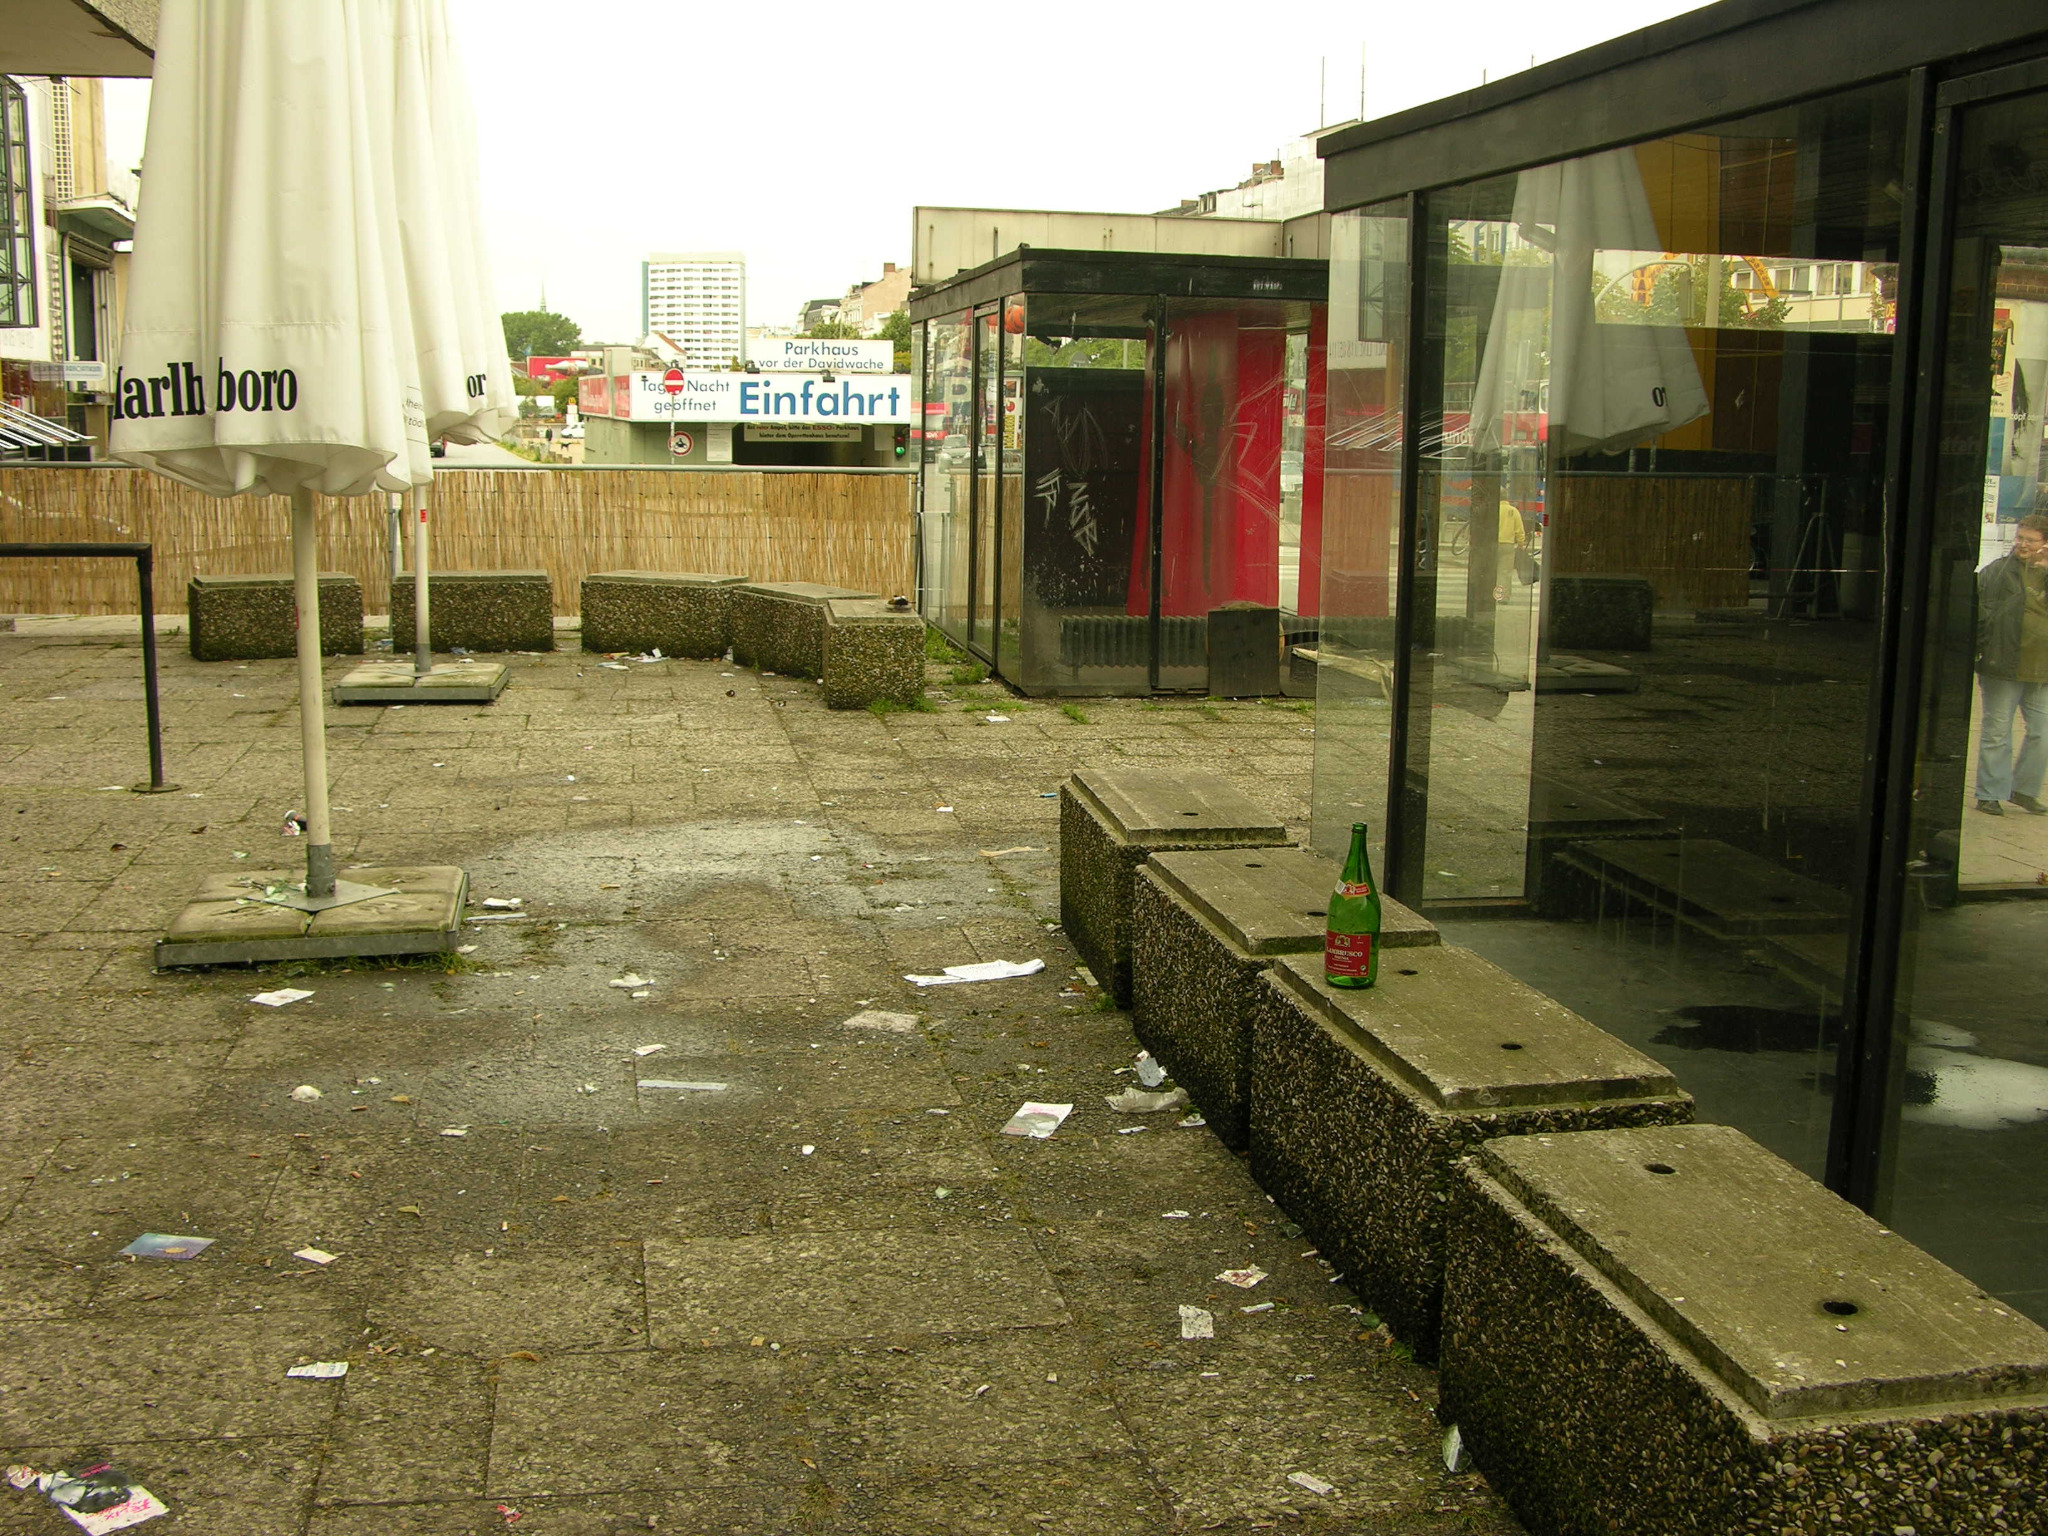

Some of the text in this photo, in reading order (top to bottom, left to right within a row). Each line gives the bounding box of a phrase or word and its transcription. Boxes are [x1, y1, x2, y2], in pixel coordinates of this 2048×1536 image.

[785, 341, 859, 356] Parkhaus
[758, 357, 884, 370] vor der Davidwache
[467, 373, 487, 398] or
[641, 378, 730, 395] Tag Nacht
[654, 398, 716, 414] geöffnet
[740, 380, 900, 416] Einfahrt
